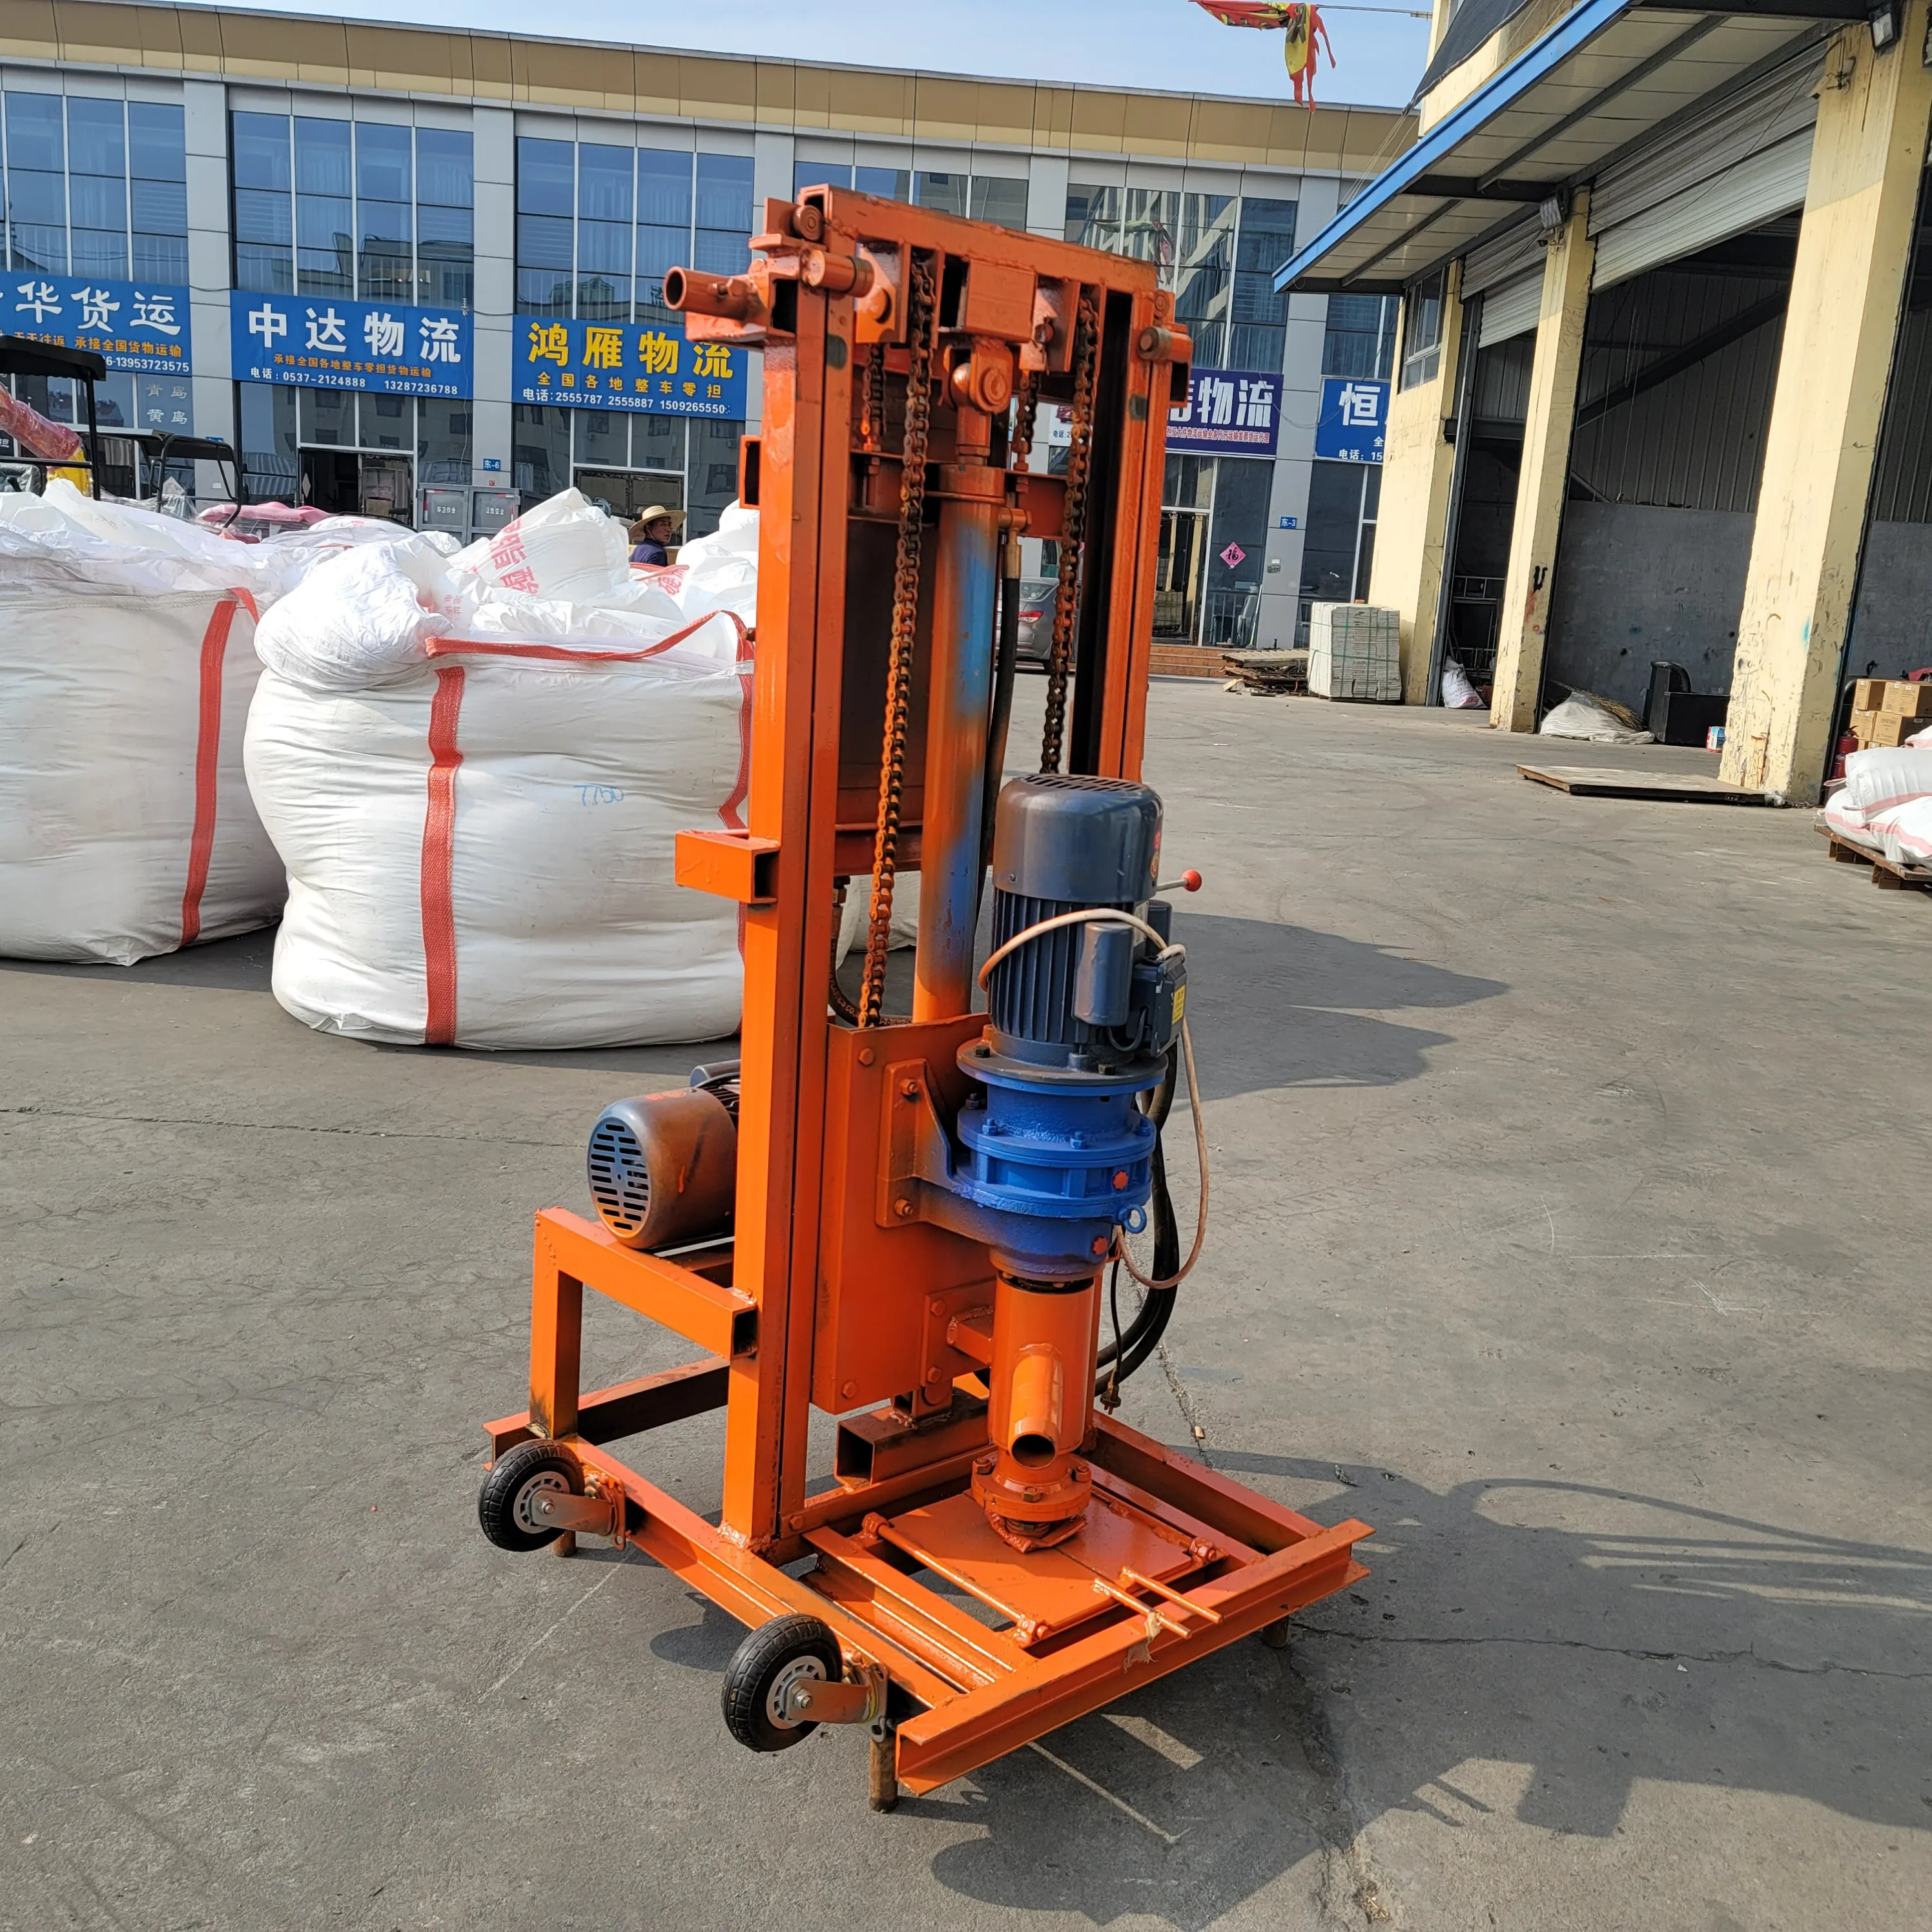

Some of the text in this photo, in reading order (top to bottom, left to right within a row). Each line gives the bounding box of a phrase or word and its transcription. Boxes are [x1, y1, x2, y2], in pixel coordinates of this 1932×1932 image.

[0, 281, 181, 335] 华货运
[249, 303, 461, 363] 中达物流
[74, 336, 182, 358] 承接全国货物运输
[528, 322, 734, 378] 鸿雁物流
[274, 353, 432, 378] 承接全国各地整车零担货物运输
[146, 384, 188, 400] 青岛
[384, 380, 458, 395] 13287236788
[537, 371, 721, 398] 全国各地整车零担
[608, 395, 653, 408] 2555887
[660, 400, 731, 414] 1509265550
[1339, 382, 1388, 426] 恒
[147, 408, 188, 425] 黄岛
[1373, 436, 1384, 447] 全
[484, 459, 500, 469] 东-6
[1280, 517, 1296, 527] 东-3
